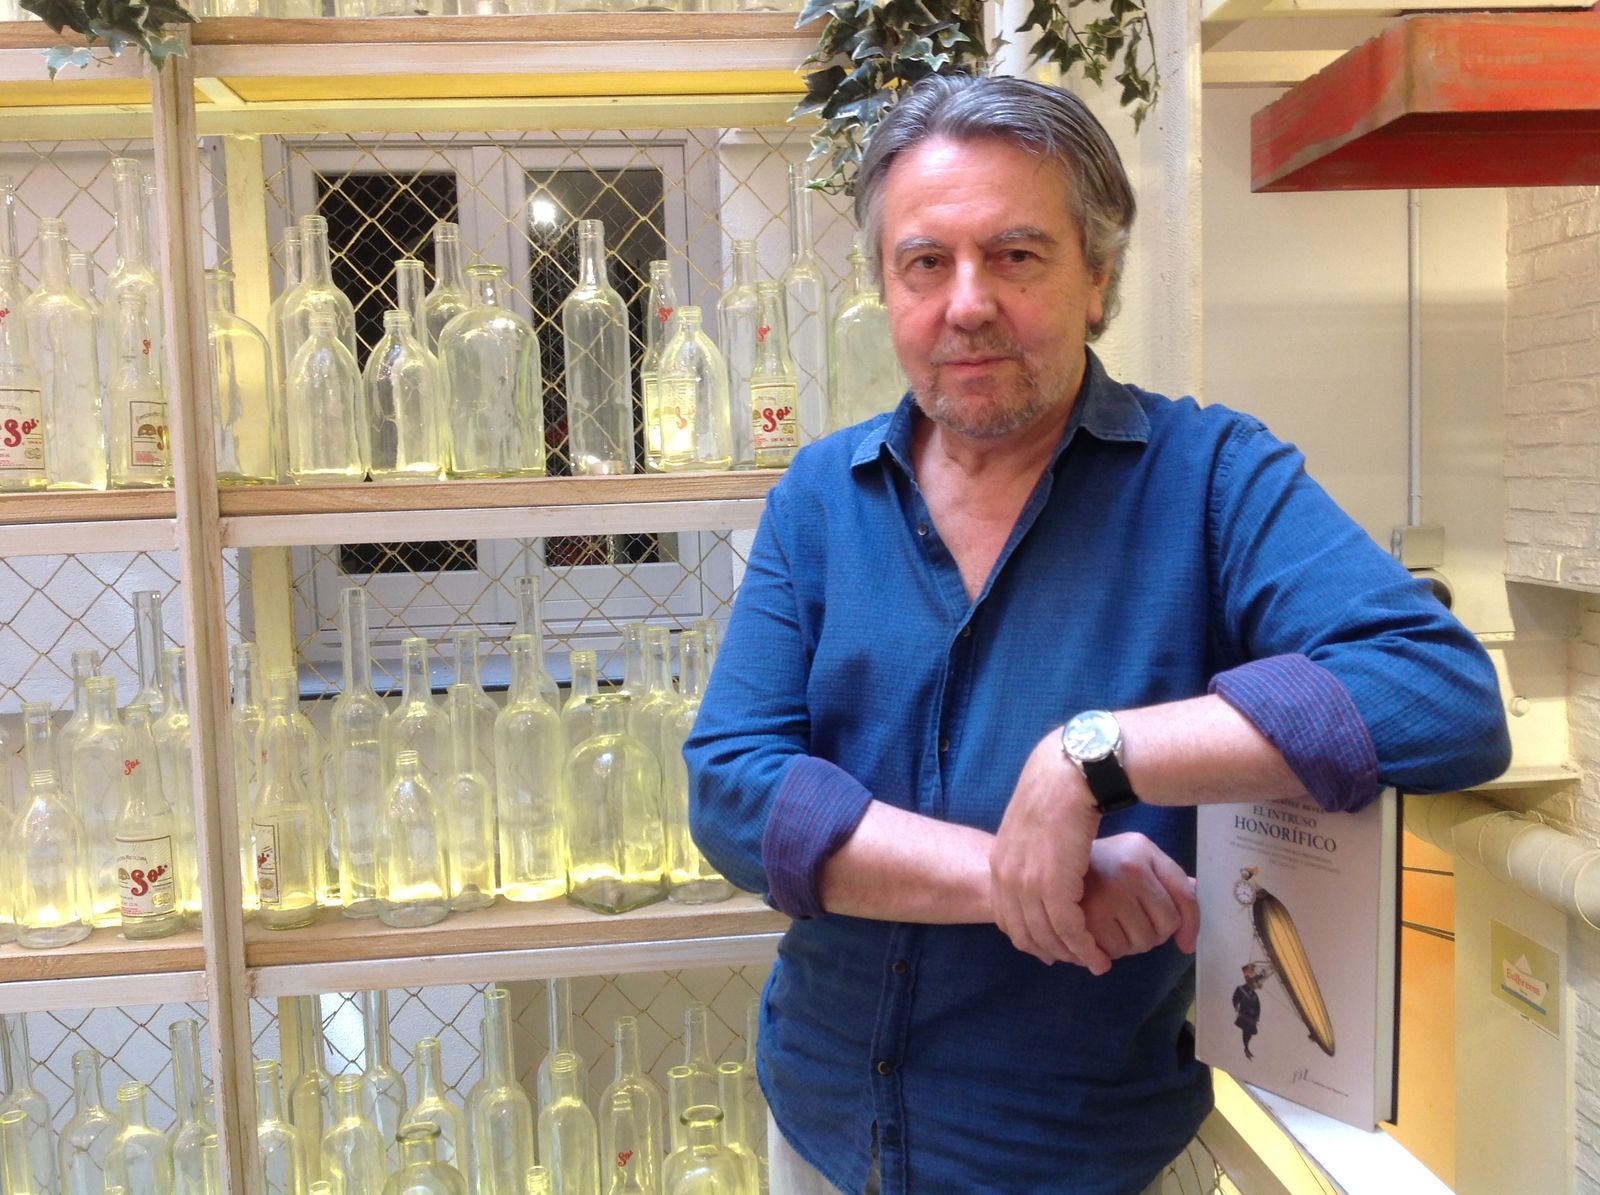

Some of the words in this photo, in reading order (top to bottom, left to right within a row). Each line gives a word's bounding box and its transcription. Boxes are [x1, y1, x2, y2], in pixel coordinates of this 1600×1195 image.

[4, 418, 38, 447] Sol
[762, 406, 792, 433] Sol
[1253, 805, 1265, 816] EL
[1268, 808, 1317, 828] INTRUSO
[1234, 815, 1337, 853] HONORÍFICO
[131, 865, 167, 897] Sol
